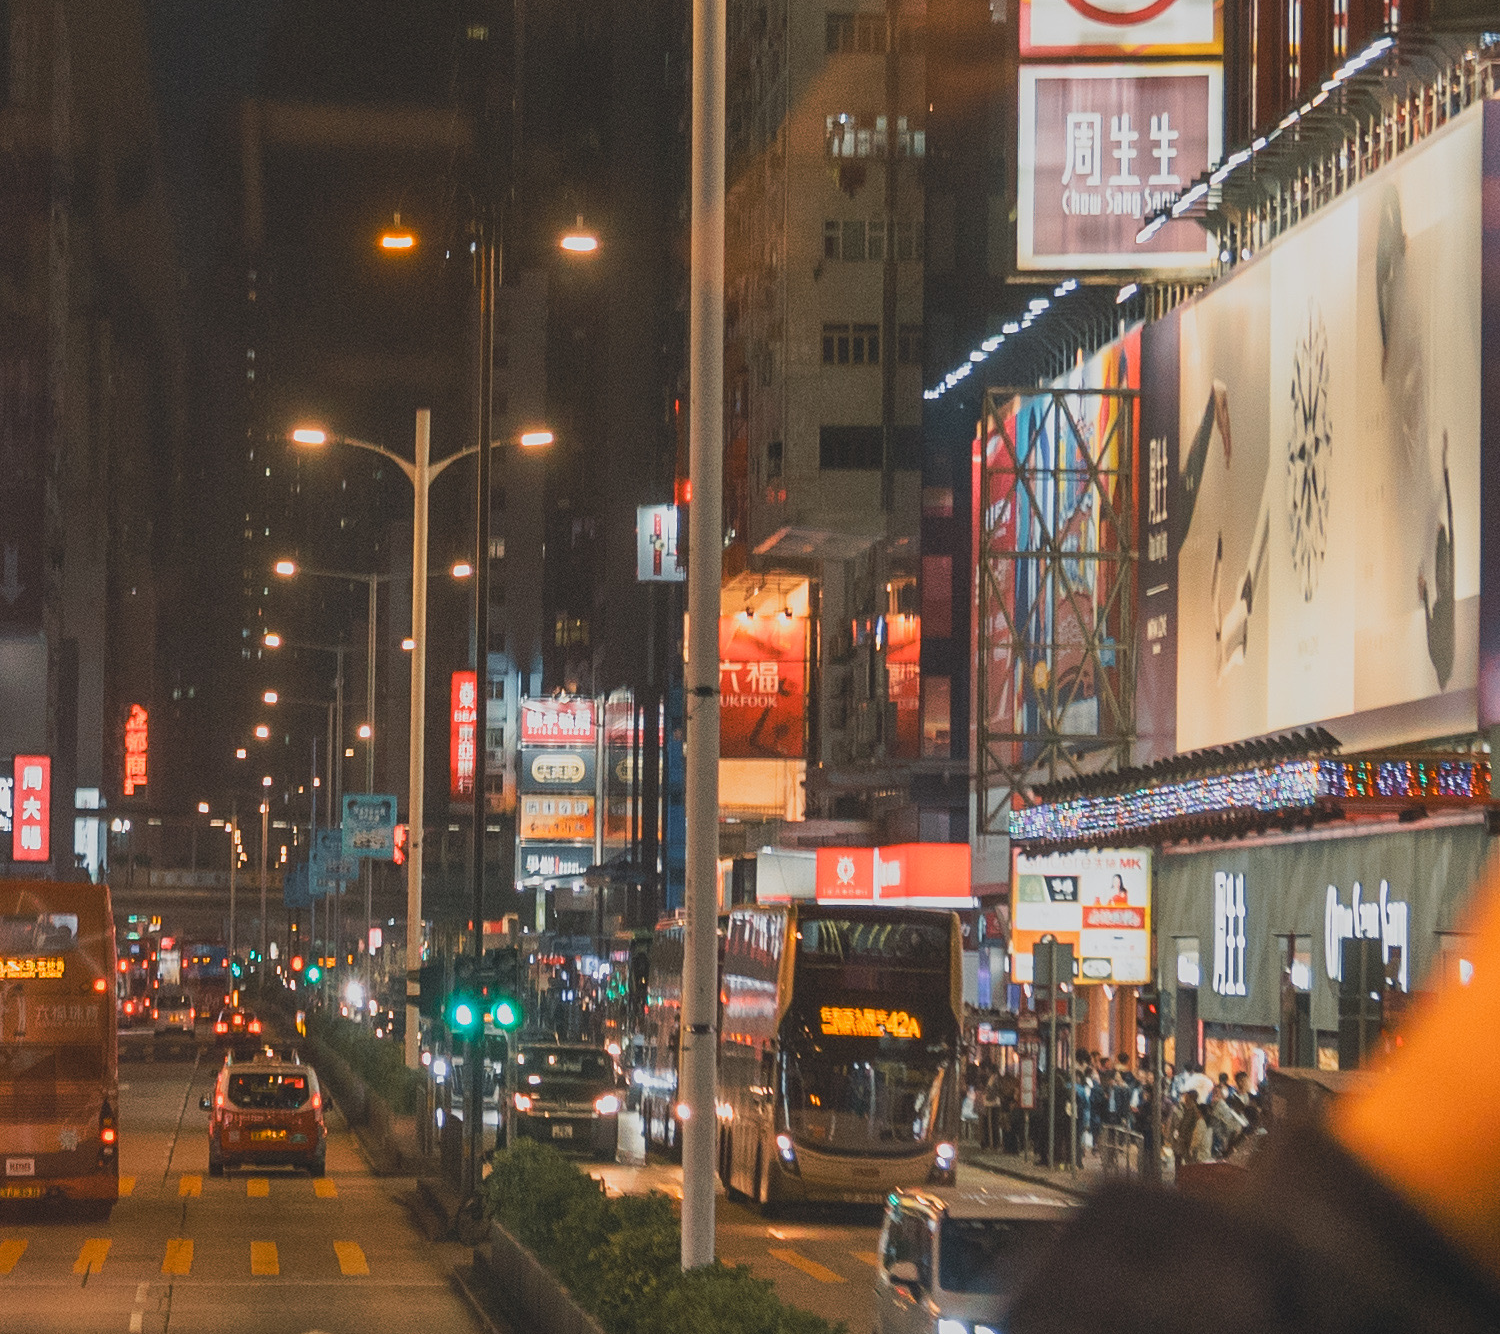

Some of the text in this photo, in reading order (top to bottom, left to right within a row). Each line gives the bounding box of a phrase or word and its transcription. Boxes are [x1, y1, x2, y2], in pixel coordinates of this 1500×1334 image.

[1061, 113, 1180, 186] 周生生
[1062, 188, 1102, 216] Chow
[1106, 187, 1142, 219] Sang
[720, 694, 778, 708] UKFOOK
[884, 1011, 921, 1039] 42A
